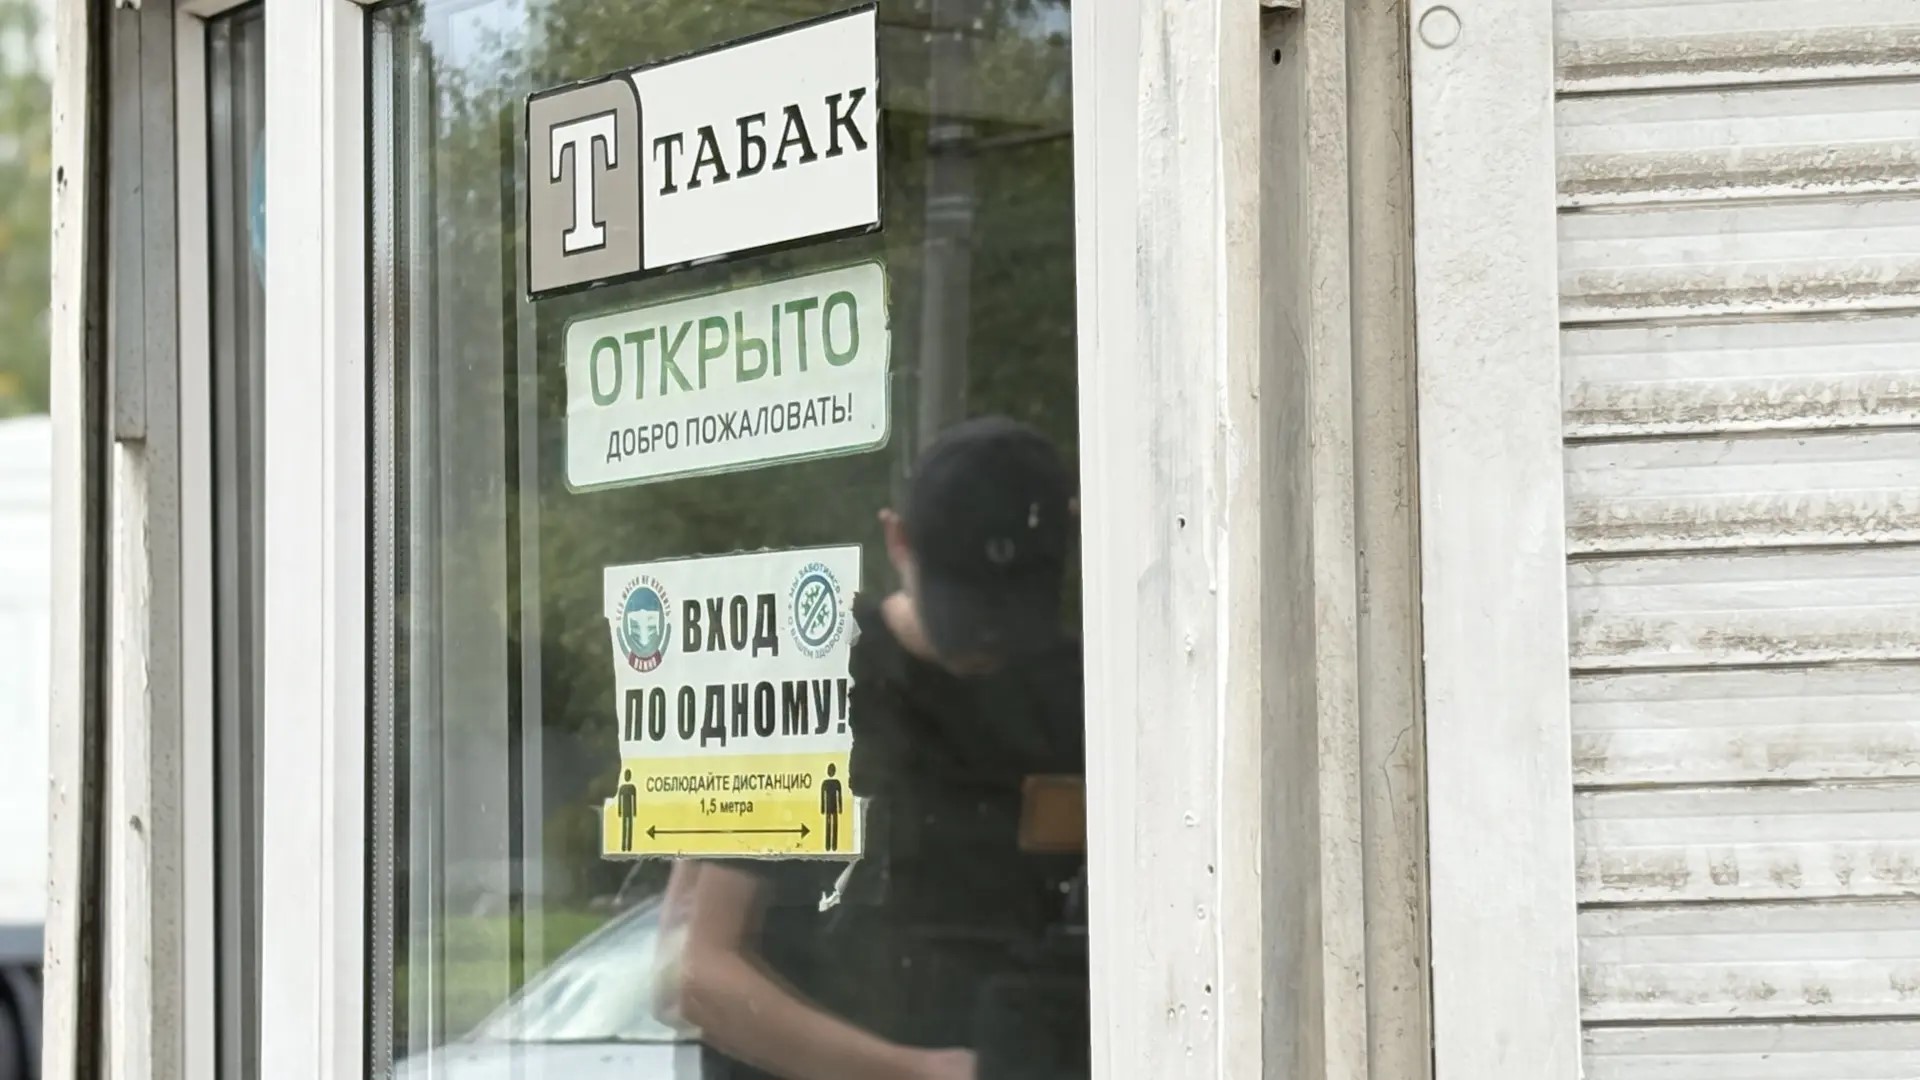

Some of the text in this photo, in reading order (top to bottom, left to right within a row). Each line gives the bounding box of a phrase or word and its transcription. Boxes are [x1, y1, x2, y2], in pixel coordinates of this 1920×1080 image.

[653, 86, 868, 197] ТАБАК
[549, 107, 618, 258] Т
[589, 290, 860, 407] ОТКРЫТО
[606, 392, 853, 464] ДОБРО ПОЖАЛОВАТЬ!
[682, 593, 779, 658] ВХОД
[624, 678, 848, 747] ПО ОДНОМУ!
[646, 772, 812, 794] СОБЛЮДАЙТЕ ДИСТАНЦИЮ
[700, 798, 754, 817] 1,5 метра
